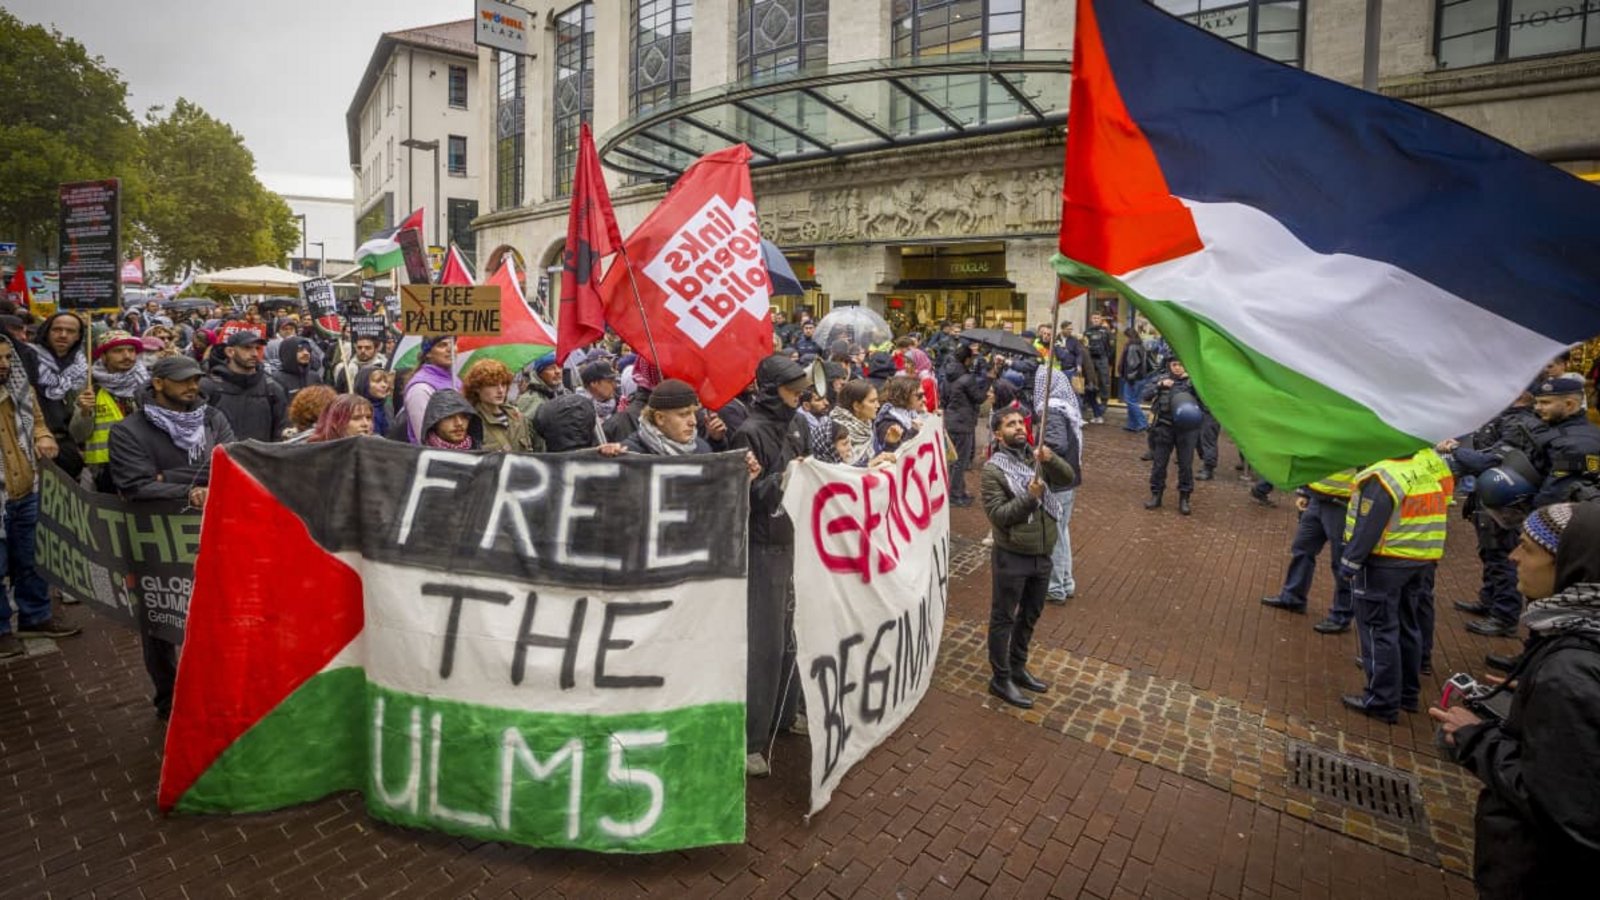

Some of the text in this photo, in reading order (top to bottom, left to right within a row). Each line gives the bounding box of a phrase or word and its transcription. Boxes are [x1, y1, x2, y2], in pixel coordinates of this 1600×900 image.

[482, 23, 522, 40] PLAZA
[405, 309, 500, 333] PALESTINE
[431, 287, 474, 306] FREE
[40, 469, 203, 563] BREAK THE
[397, 450, 711, 570] FREE
[811, 430, 950, 585] GENOZI
[141, 576, 192, 596] GLOB
[421, 582, 674, 690] THE
[810, 585, 934, 786] BEGINN
[374, 697, 668, 841] ULM5
